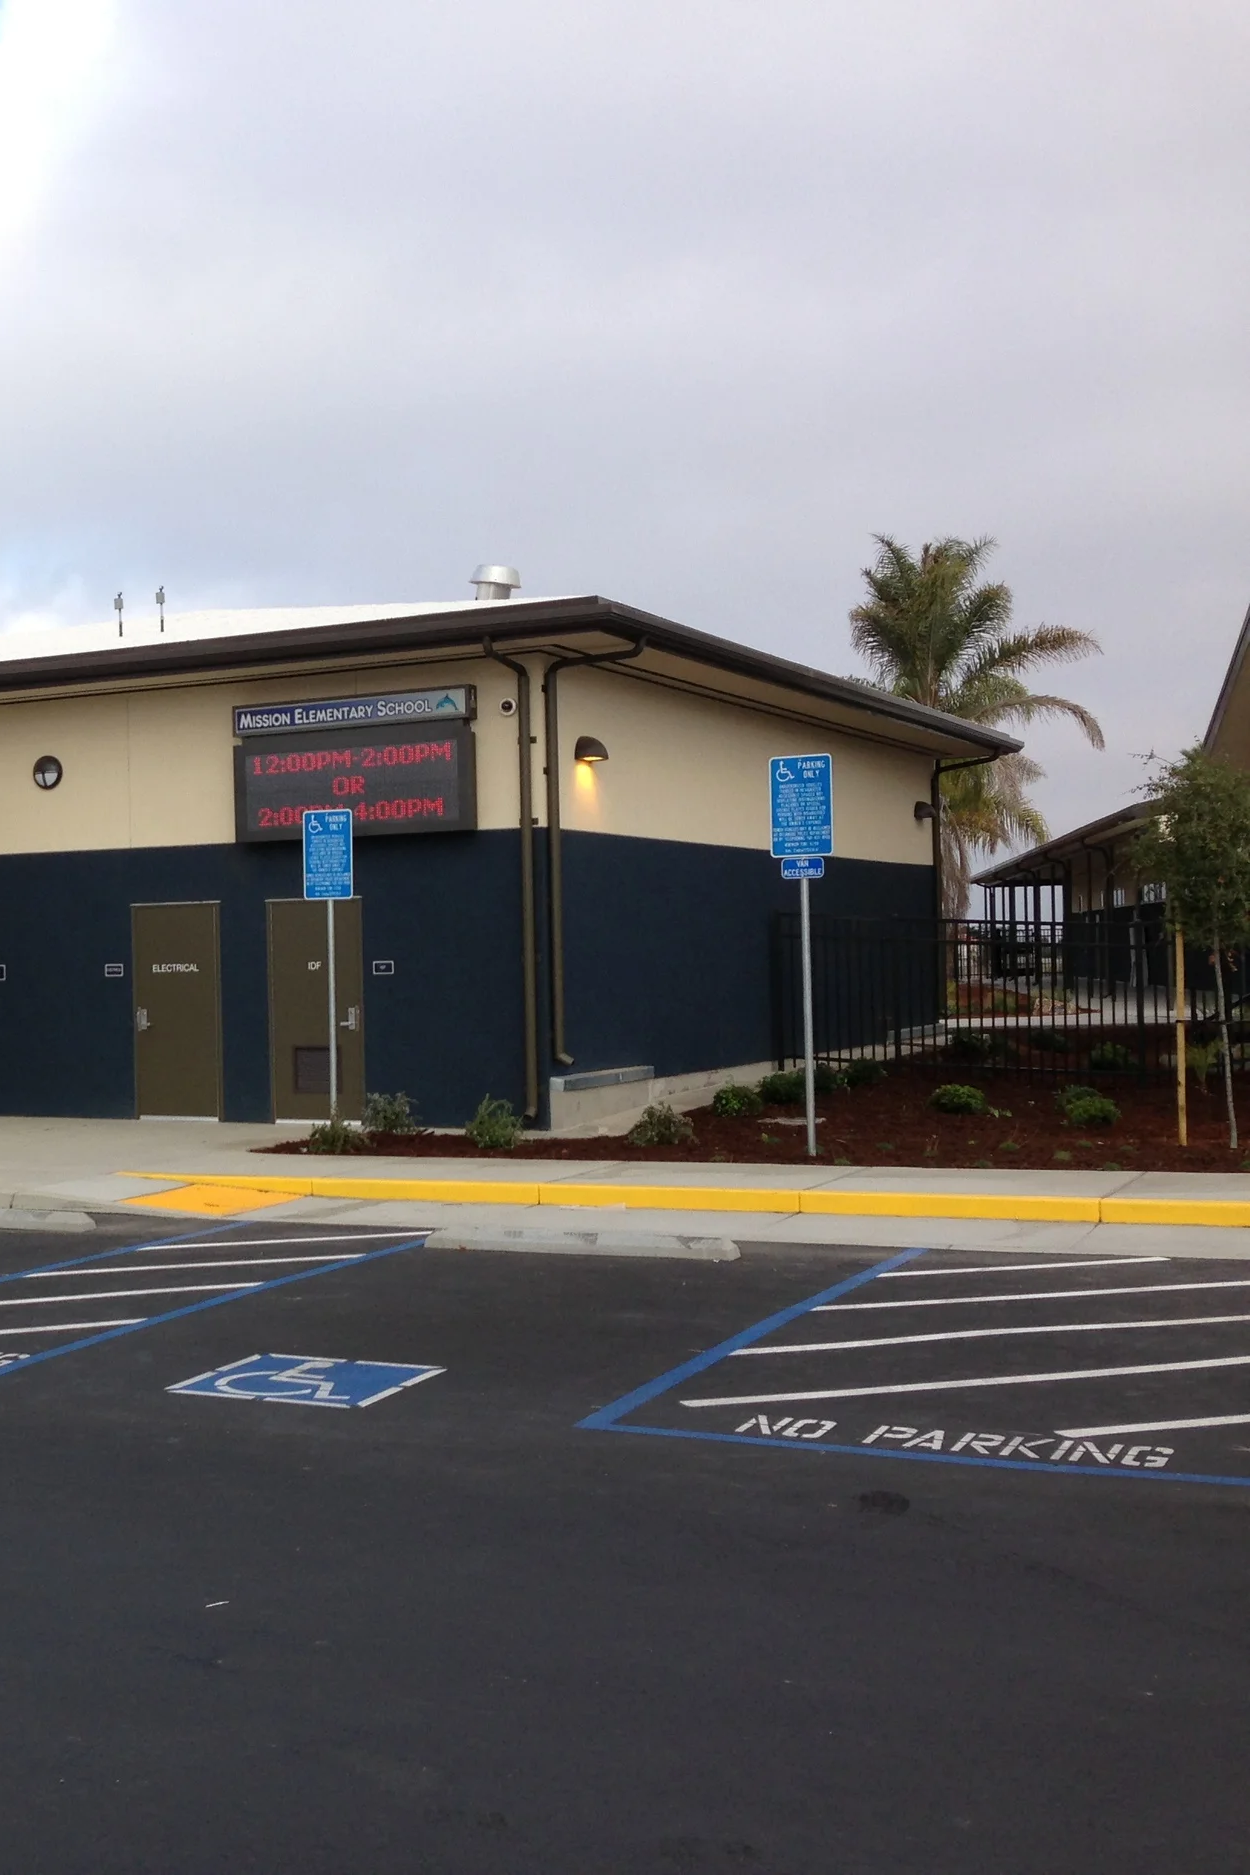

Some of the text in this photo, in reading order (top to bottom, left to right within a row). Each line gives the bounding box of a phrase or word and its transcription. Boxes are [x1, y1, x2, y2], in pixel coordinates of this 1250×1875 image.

[798, 760, 826, 770] PARKING
[803, 770, 820, 779] ONLY
[332, 775, 365, 796] OR
[796, 860, 809, 868] VAN
[784, 867, 822, 877] ACCESSIBLE
[152, 963, 199, 973] ELECTRICAL
[307, 961, 322, 970] IDF
[734, 1414, 1175, 1469] NO PARKING
